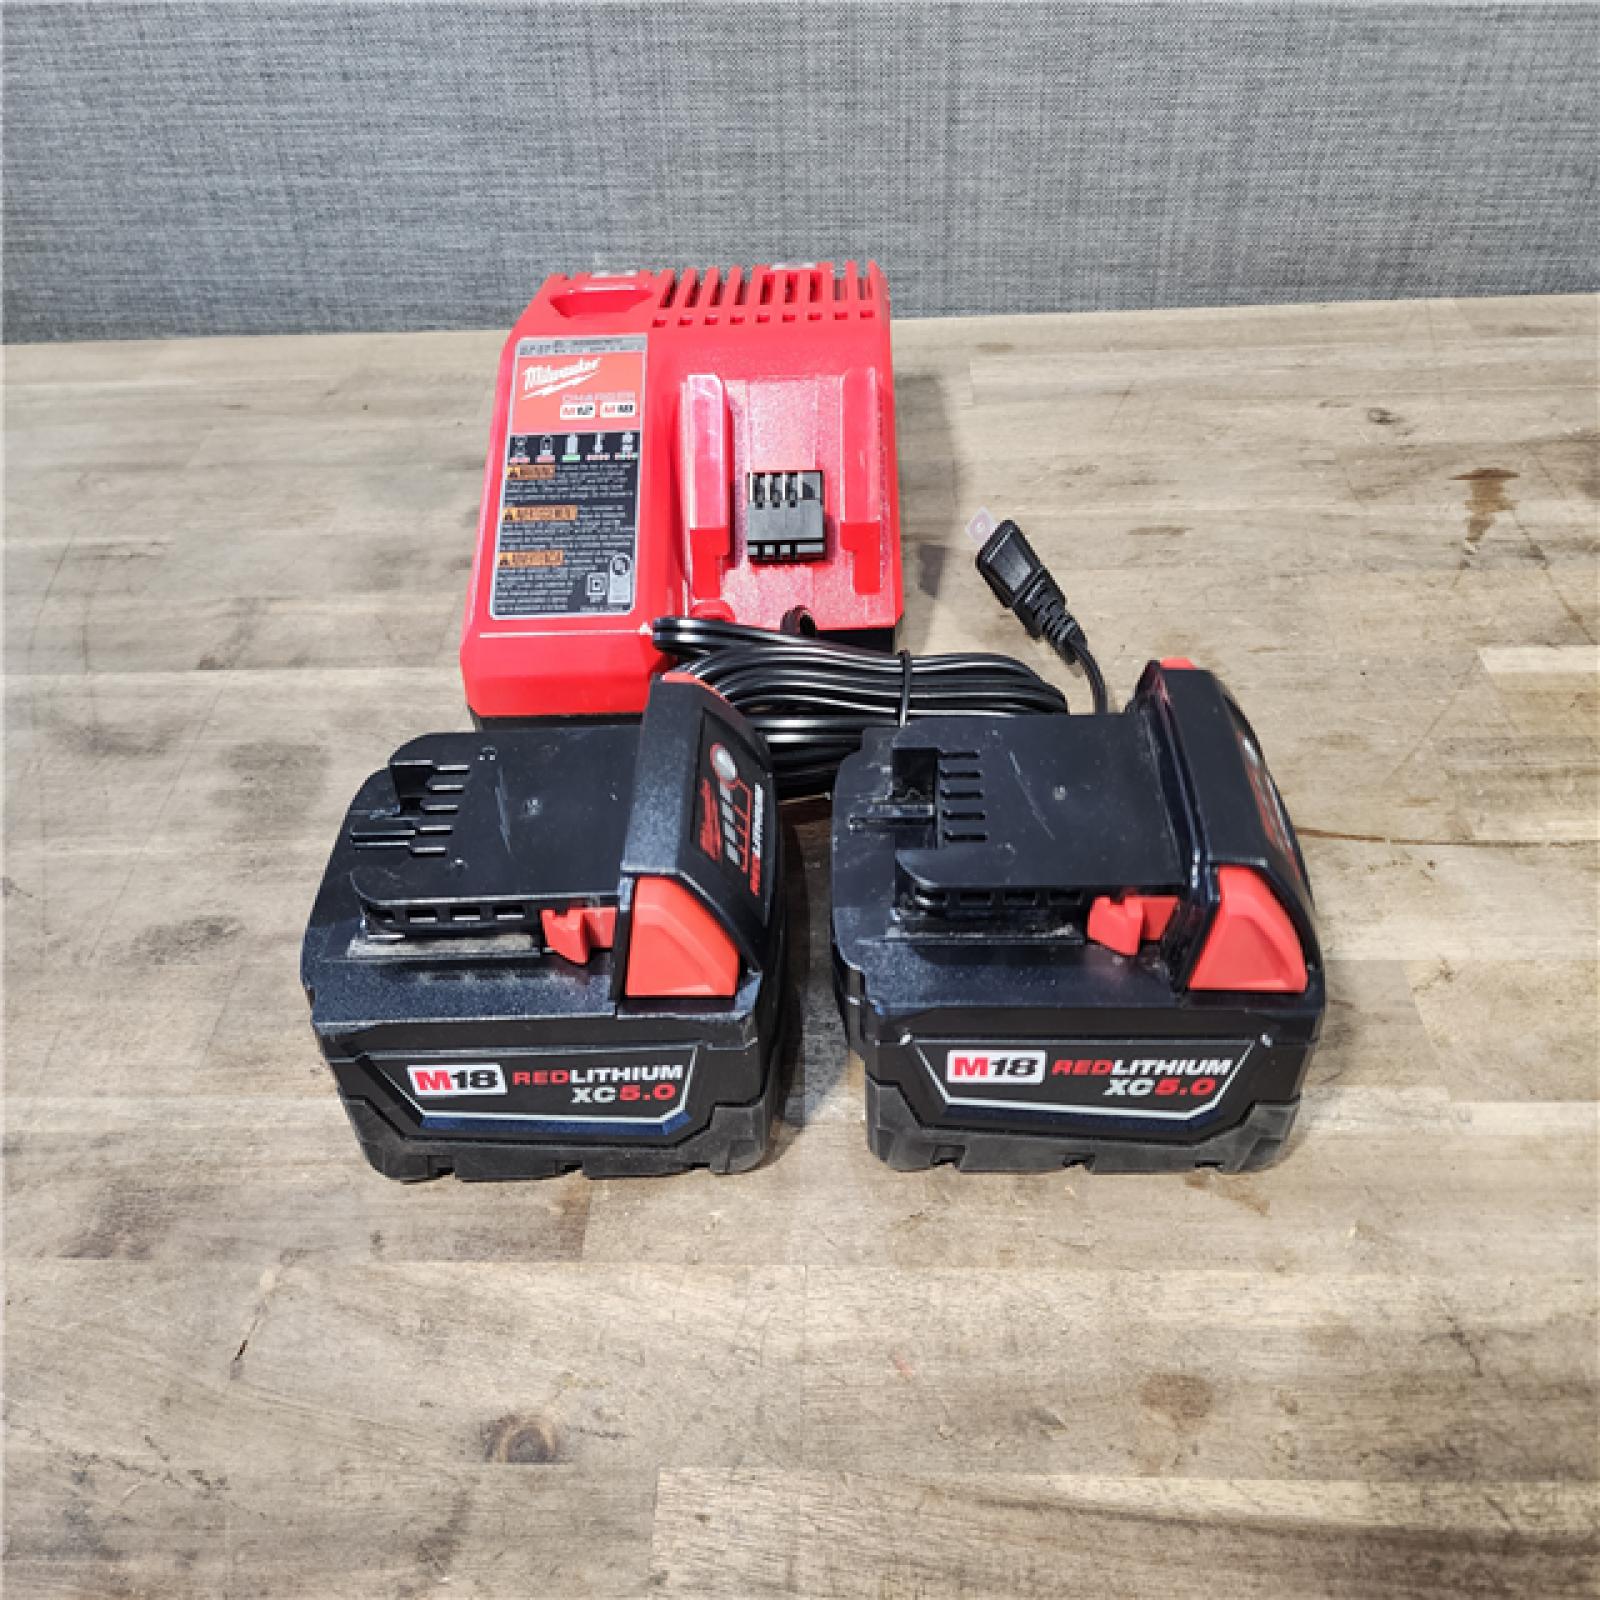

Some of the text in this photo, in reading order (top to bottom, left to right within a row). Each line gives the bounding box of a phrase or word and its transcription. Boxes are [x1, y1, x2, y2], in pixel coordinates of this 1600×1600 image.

[951, 1055, 1234, 1078] M18 REDLITHIUM
[411, 1064, 684, 1092] M18 REDLITHIUM
[1102, 1078, 1217, 1097] XC5.0
[570, 1084, 677, 1104] XC5.0
